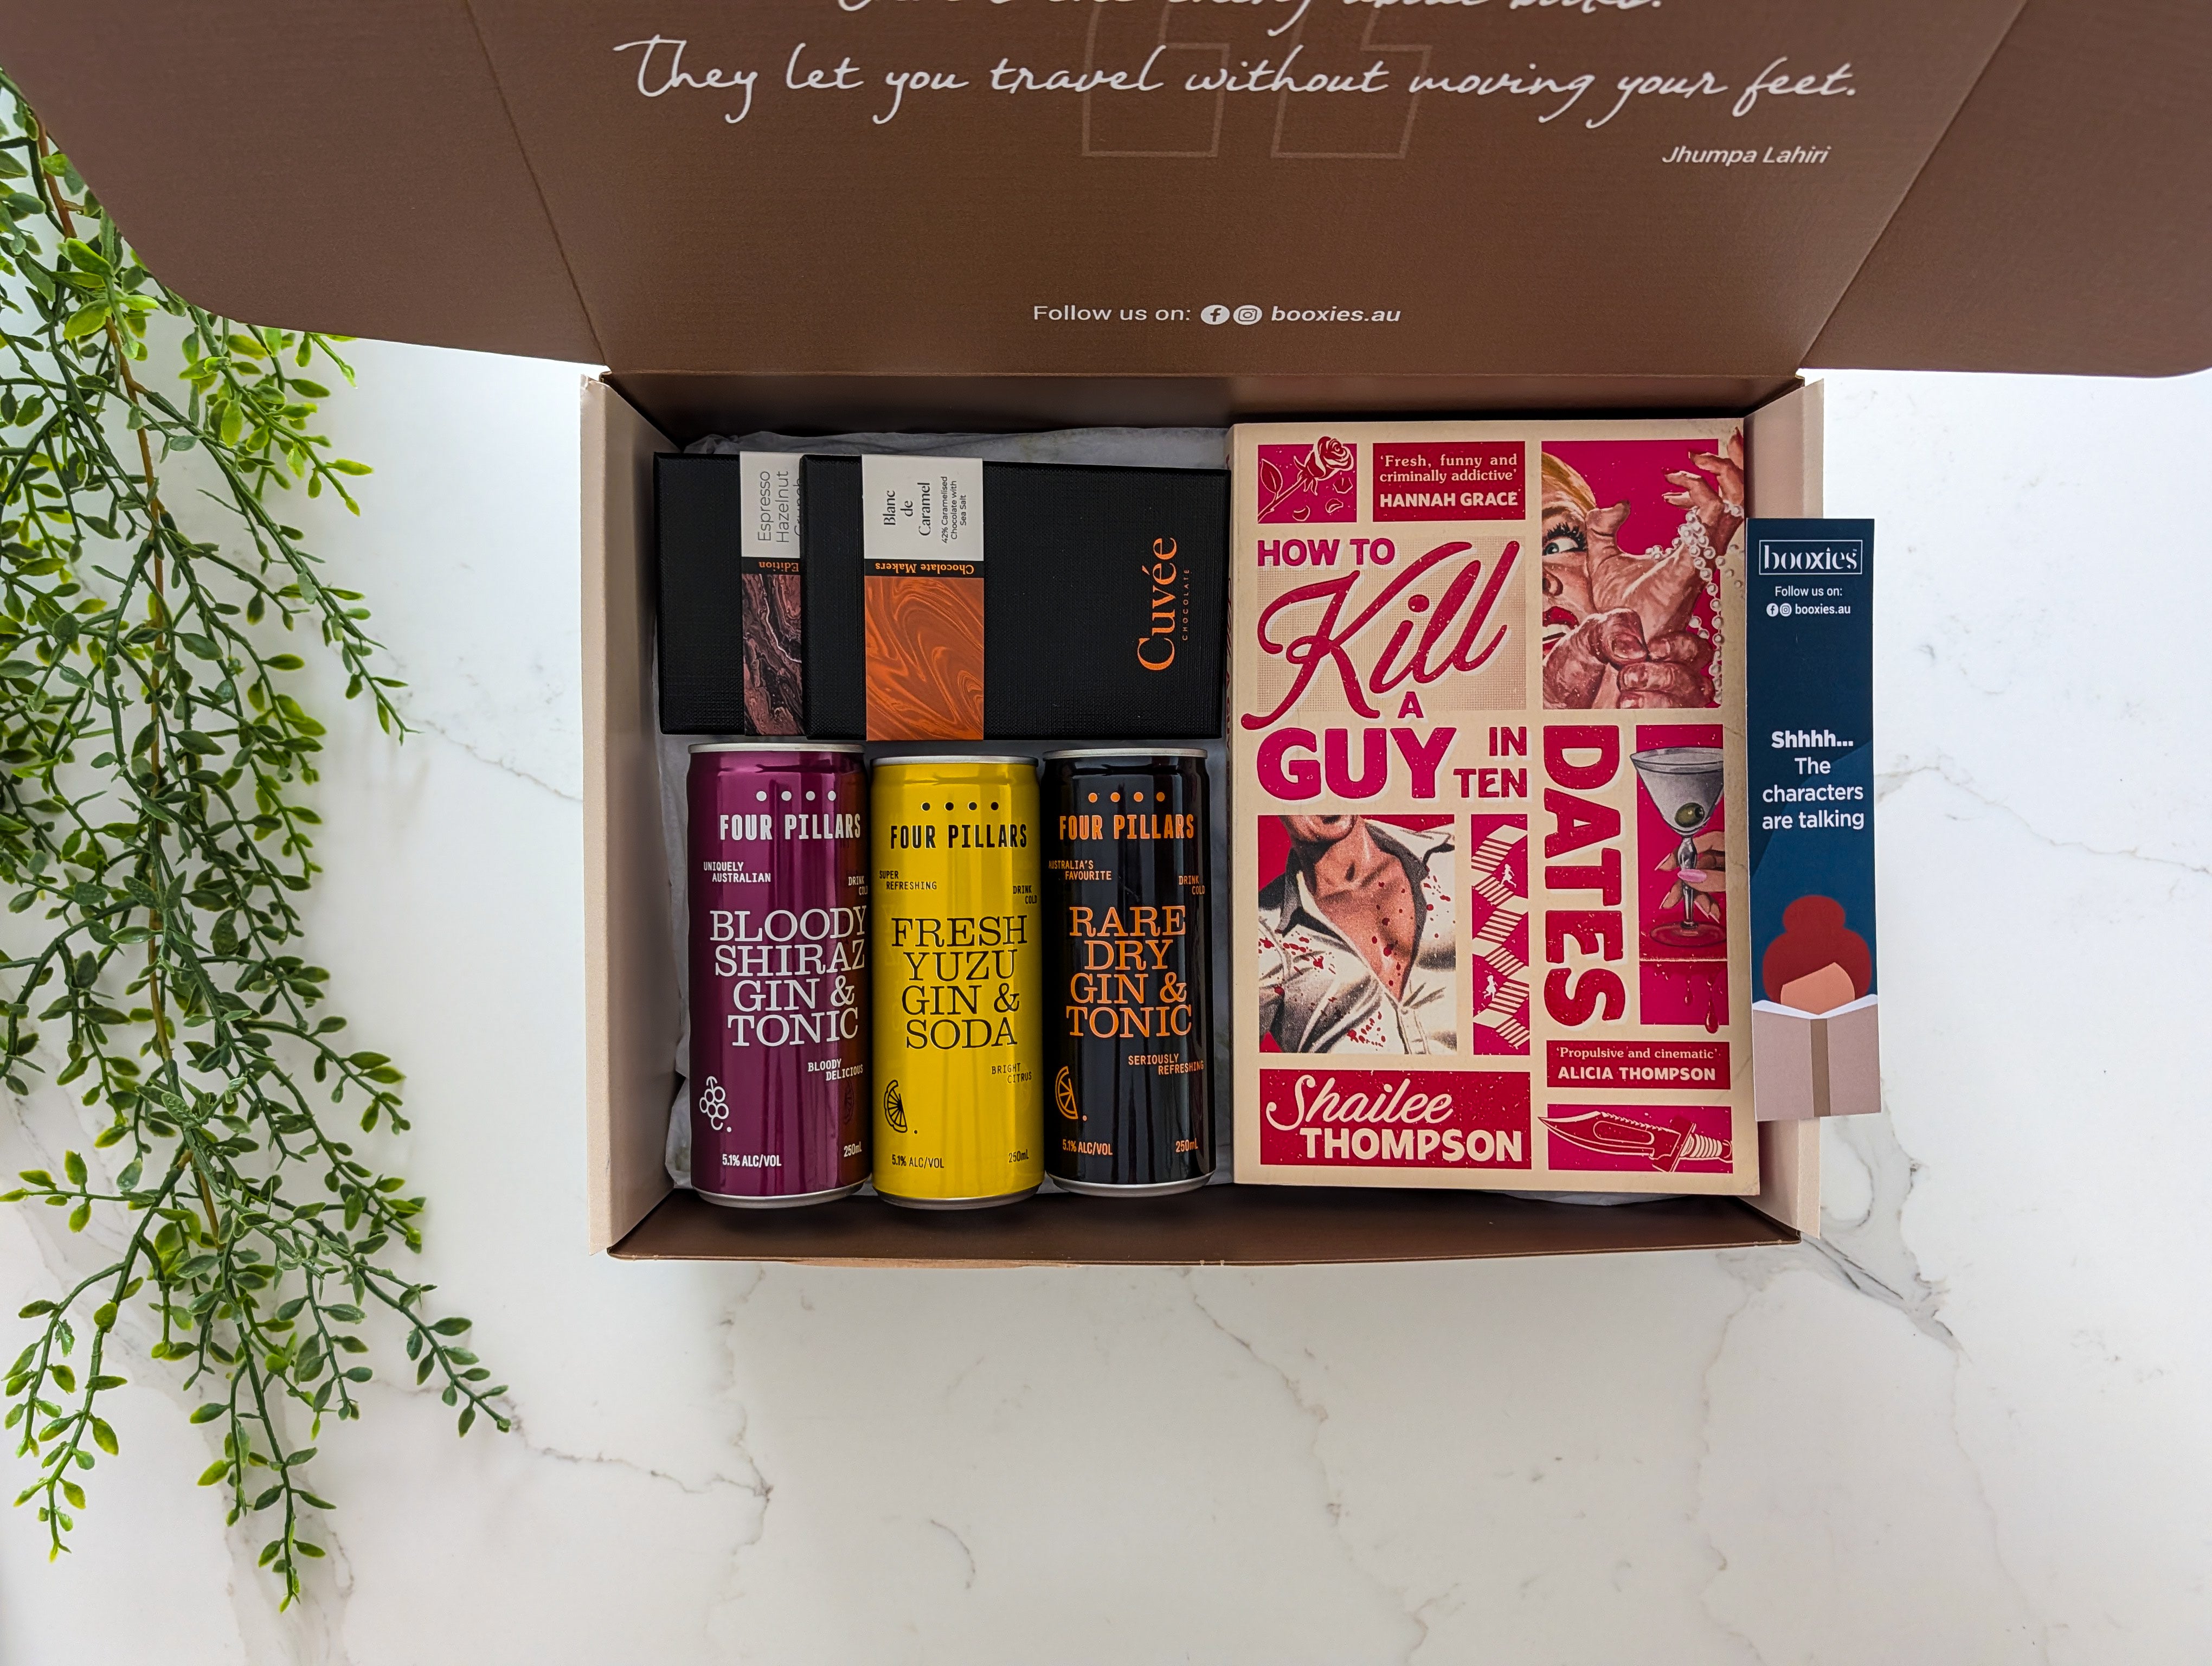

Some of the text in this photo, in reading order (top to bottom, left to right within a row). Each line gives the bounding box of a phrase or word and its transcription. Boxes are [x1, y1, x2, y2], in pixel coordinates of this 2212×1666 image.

[613, 34, 1857, 129] They let you travel without moving your feet.
[1662, 146, 1831, 167] Jhumpa Lahiri
[1033, 305, 1401, 322] Follow us on: booxies.au
[1440, 454, 1482, 469] funny
[1490, 453, 1517, 466] and
[1380, 469, 1447, 483] criminally
[758, 471, 773, 542] Espresso
[775, 471, 789, 543] Hazelnut
[883, 490, 896, 526] Blanc
[900, 500, 914, 517] de
[917, 482, 931, 536] Caramel
[1380, 492, 1518, 508] HANNAH GRACE
[1257, 538, 1396, 567] HOW TO
[1764, 545, 1857, 569] booxies
[758, 562, 799, 573] Edition
[876, 562, 975, 575] Chocolate Makers
[1775, 586, 1843, 597] Follow us on:
[1137, 537, 1177, 671] Cuvée
[1795, 603, 1851, 614] booxies.au
[1240, 541, 1520, 730] Kill
[1398, 691, 1424, 719] A
[1489, 726, 1527, 757] IN
[1771, 729, 1854, 748] Shhhh...
[1257, 727, 1457, 800] GUY
[1795, 757, 1831, 774] The
[1453, 768, 1528, 798] TEN
[1763, 784, 1863, 803] characters
[720, 813, 860, 840] FOUR PILLARS
[1060, 814, 1194, 840] FOUR PILLARS
[1762, 810, 1864, 830] are talking
[890, 824, 1027, 849] FOUR PILLARS
[704, 862, 744, 872] UNIQUELY
[1049, 860, 1094, 869] AUSTRALIA'S
[712, 873, 771, 883] AUSTRALIAN
[848, 875, 865, 886] DRINK
[879, 870, 899, 879] SUPER
[1065, 870, 1111, 880] FAVOURITE
[1179, 875, 1199, 885] DRINK
[1543, 725, 1625, 1027] DATES
[886, 881, 937, 890] REFRESHING
[1013, 885, 1032, 895] DRINK
[1192, 886, 1205, 895] COLD
[1025, 894, 1038, 904] COLD
[710, 906, 867, 941] BLOODY
[1069, 905, 1186, 937] RARE
[891, 915, 1027, 947] FRESH
[715, 939, 865, 977] SHIRAZ
[1084, 939, 1173, 971] DRY
[903, 949, 1018, 982] YUZU
[734, 975, 854, 1012] GIN &
[1070, 971, 1187, 1004] GIN &
[902, 982, 1020, 1016] GIN &
[728, 1007, 858, 1047] TONIC
[1066, 1004, 1192, 1038] TONIC
[906, 1017, 1018, 1049] SODA
[1128, 1053, 1179, 1065] SERIOUSLY
[1628, 1047, 1650, 1059] and
[808, 1058, 841, 1072] BLOODY
[826, 1065, 863, 1081] DELICIOUS
[992, 1063, 1021, 1074] BRIGHT
[1158, 1060, 1204, 1075] REFRESHING
[1558, 1066, 1716, 1081] ALICIA THOMPSON
[1007, 1072, 1032, 1084] CITRUS
[1265, 1074, 1454, 1131] Shailee
[1063, 1139, 1113, 1156] 5.1% ALC/VOL
[1300, 1127, 1522, 1162] THOMPSON
[722, 1154, 781, 1168] 5.1% ALC/VOL
[892, 1154, 944, 1169] 5.1% ALC/VOL
